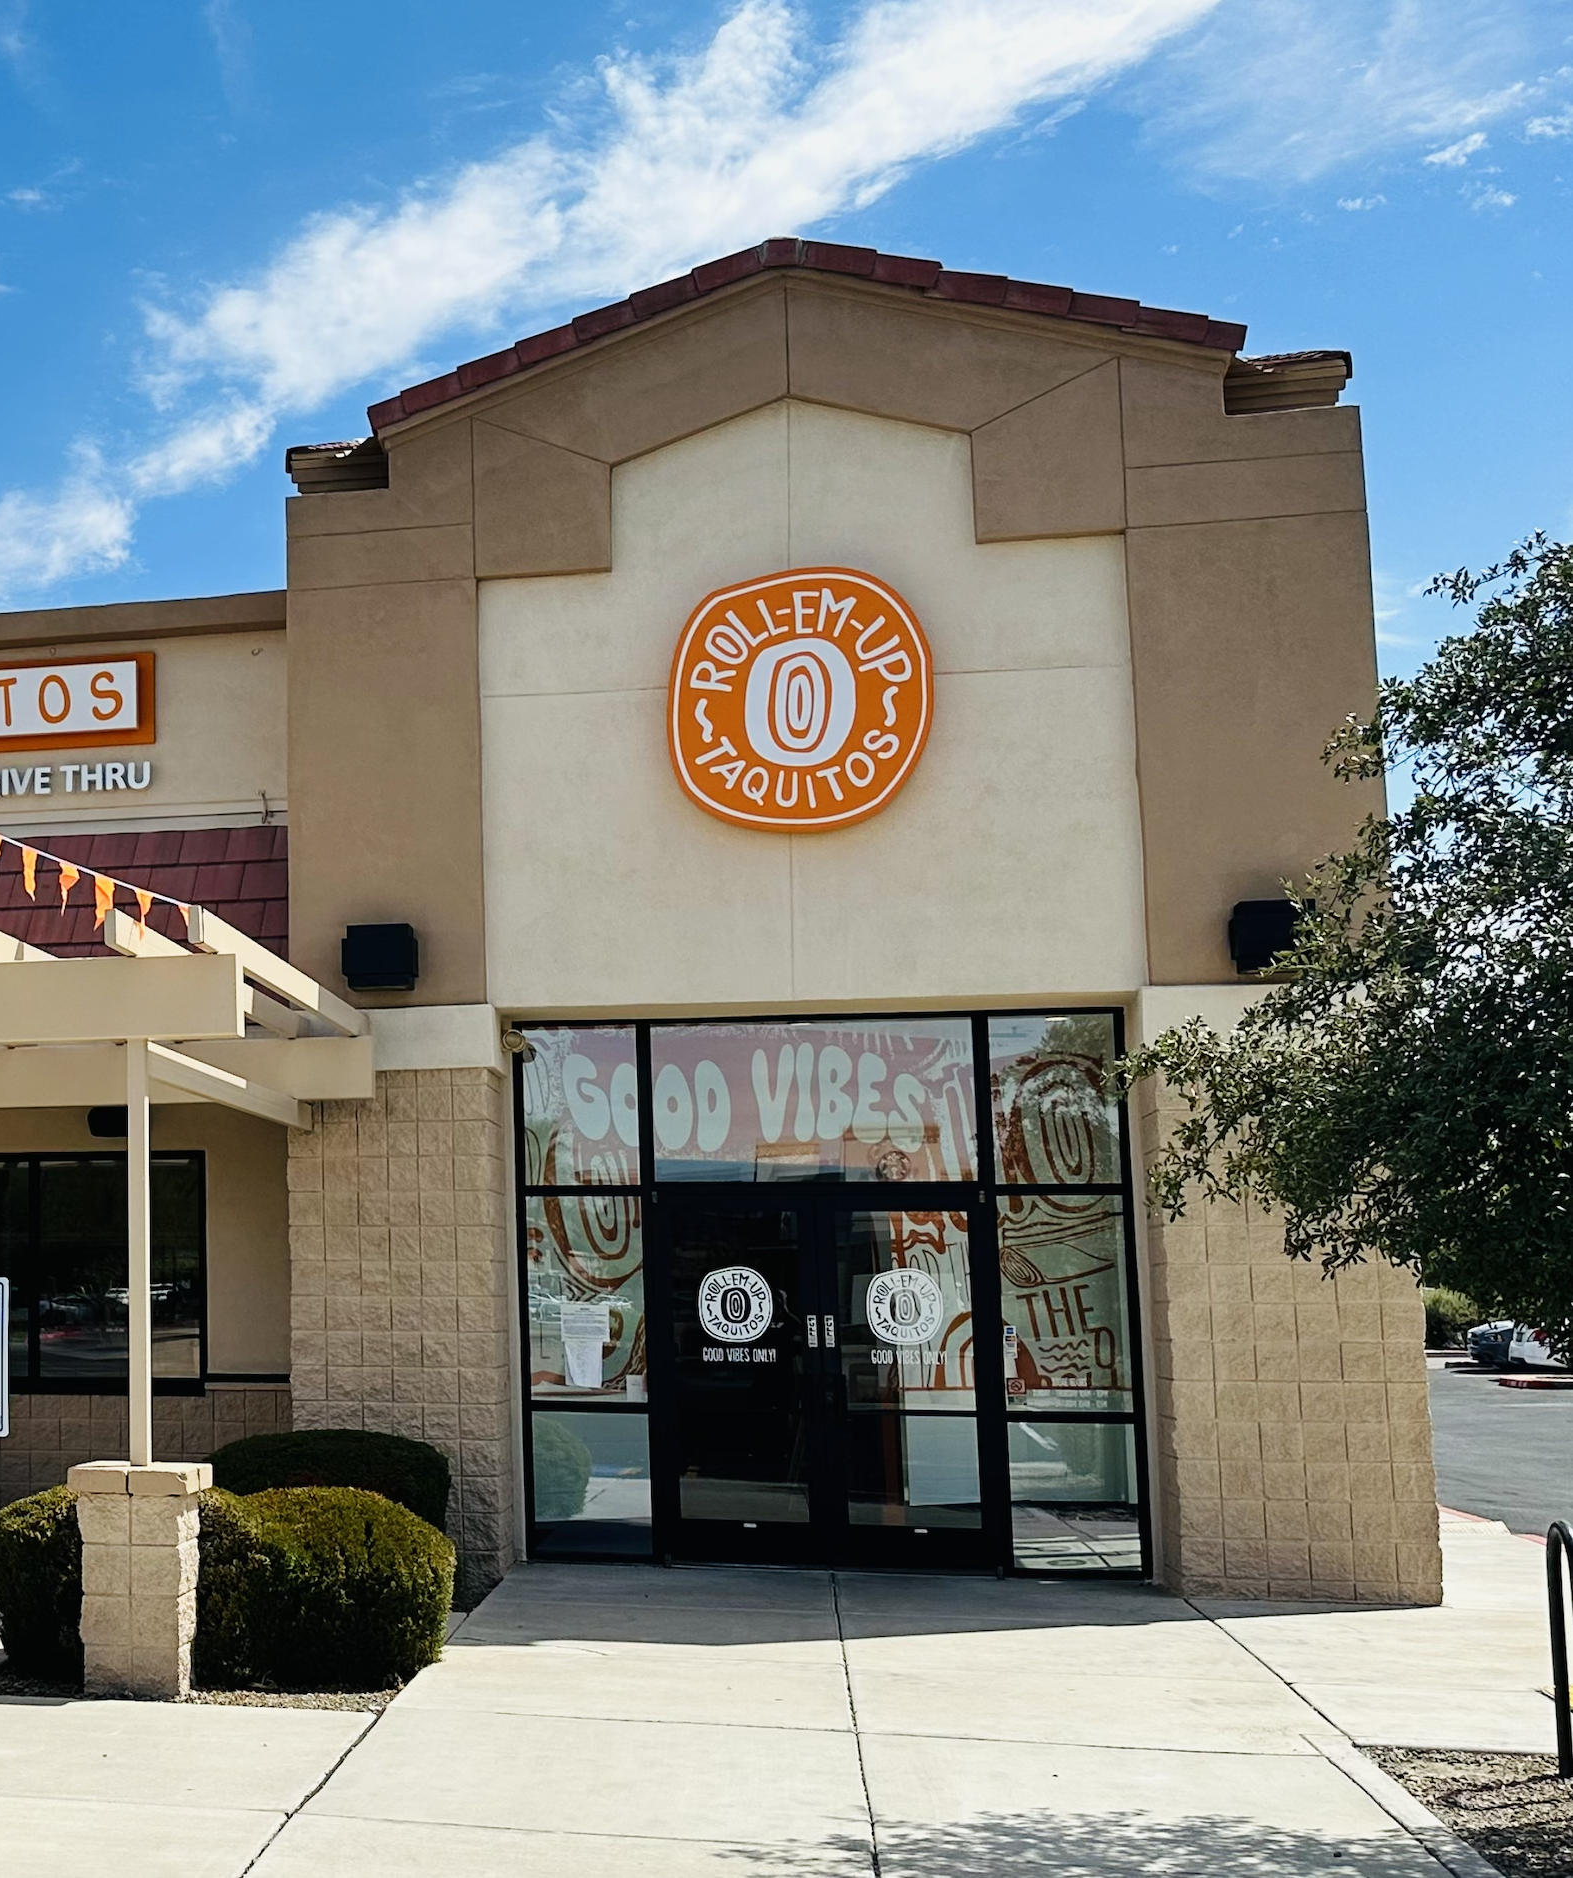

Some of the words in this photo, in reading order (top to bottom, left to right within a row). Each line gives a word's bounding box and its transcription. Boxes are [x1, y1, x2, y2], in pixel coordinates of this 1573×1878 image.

[689, 587, 912, 693] ROLL-EM-UP
[59, 760, 151, 792] THRU
[694, 729, 900, 809] TAQUITOS
[562, 1053, 731, 1152] GOOD
[752, 1042, 926, 1153] VIBES
[704, 1272, 766, 1302] ROLL-EM-UP
[873, 1274, 937, 1305] ROLL-EM-UP
[707, 1313, 764, 1336] TAQUITOS
[877, 1315, 935, 1338] TAQUITOS
[1015, 1284, 1094, 1342] THE
[702, 1347, 724, 1362] GOOD
[726, 1347, 750, 1362] VIBES
[752, 1348, 776, 1363] ONLY!
[871, 1349, 893, 1365] GOOD
[896, 1350, 920, 1365] VIBES
